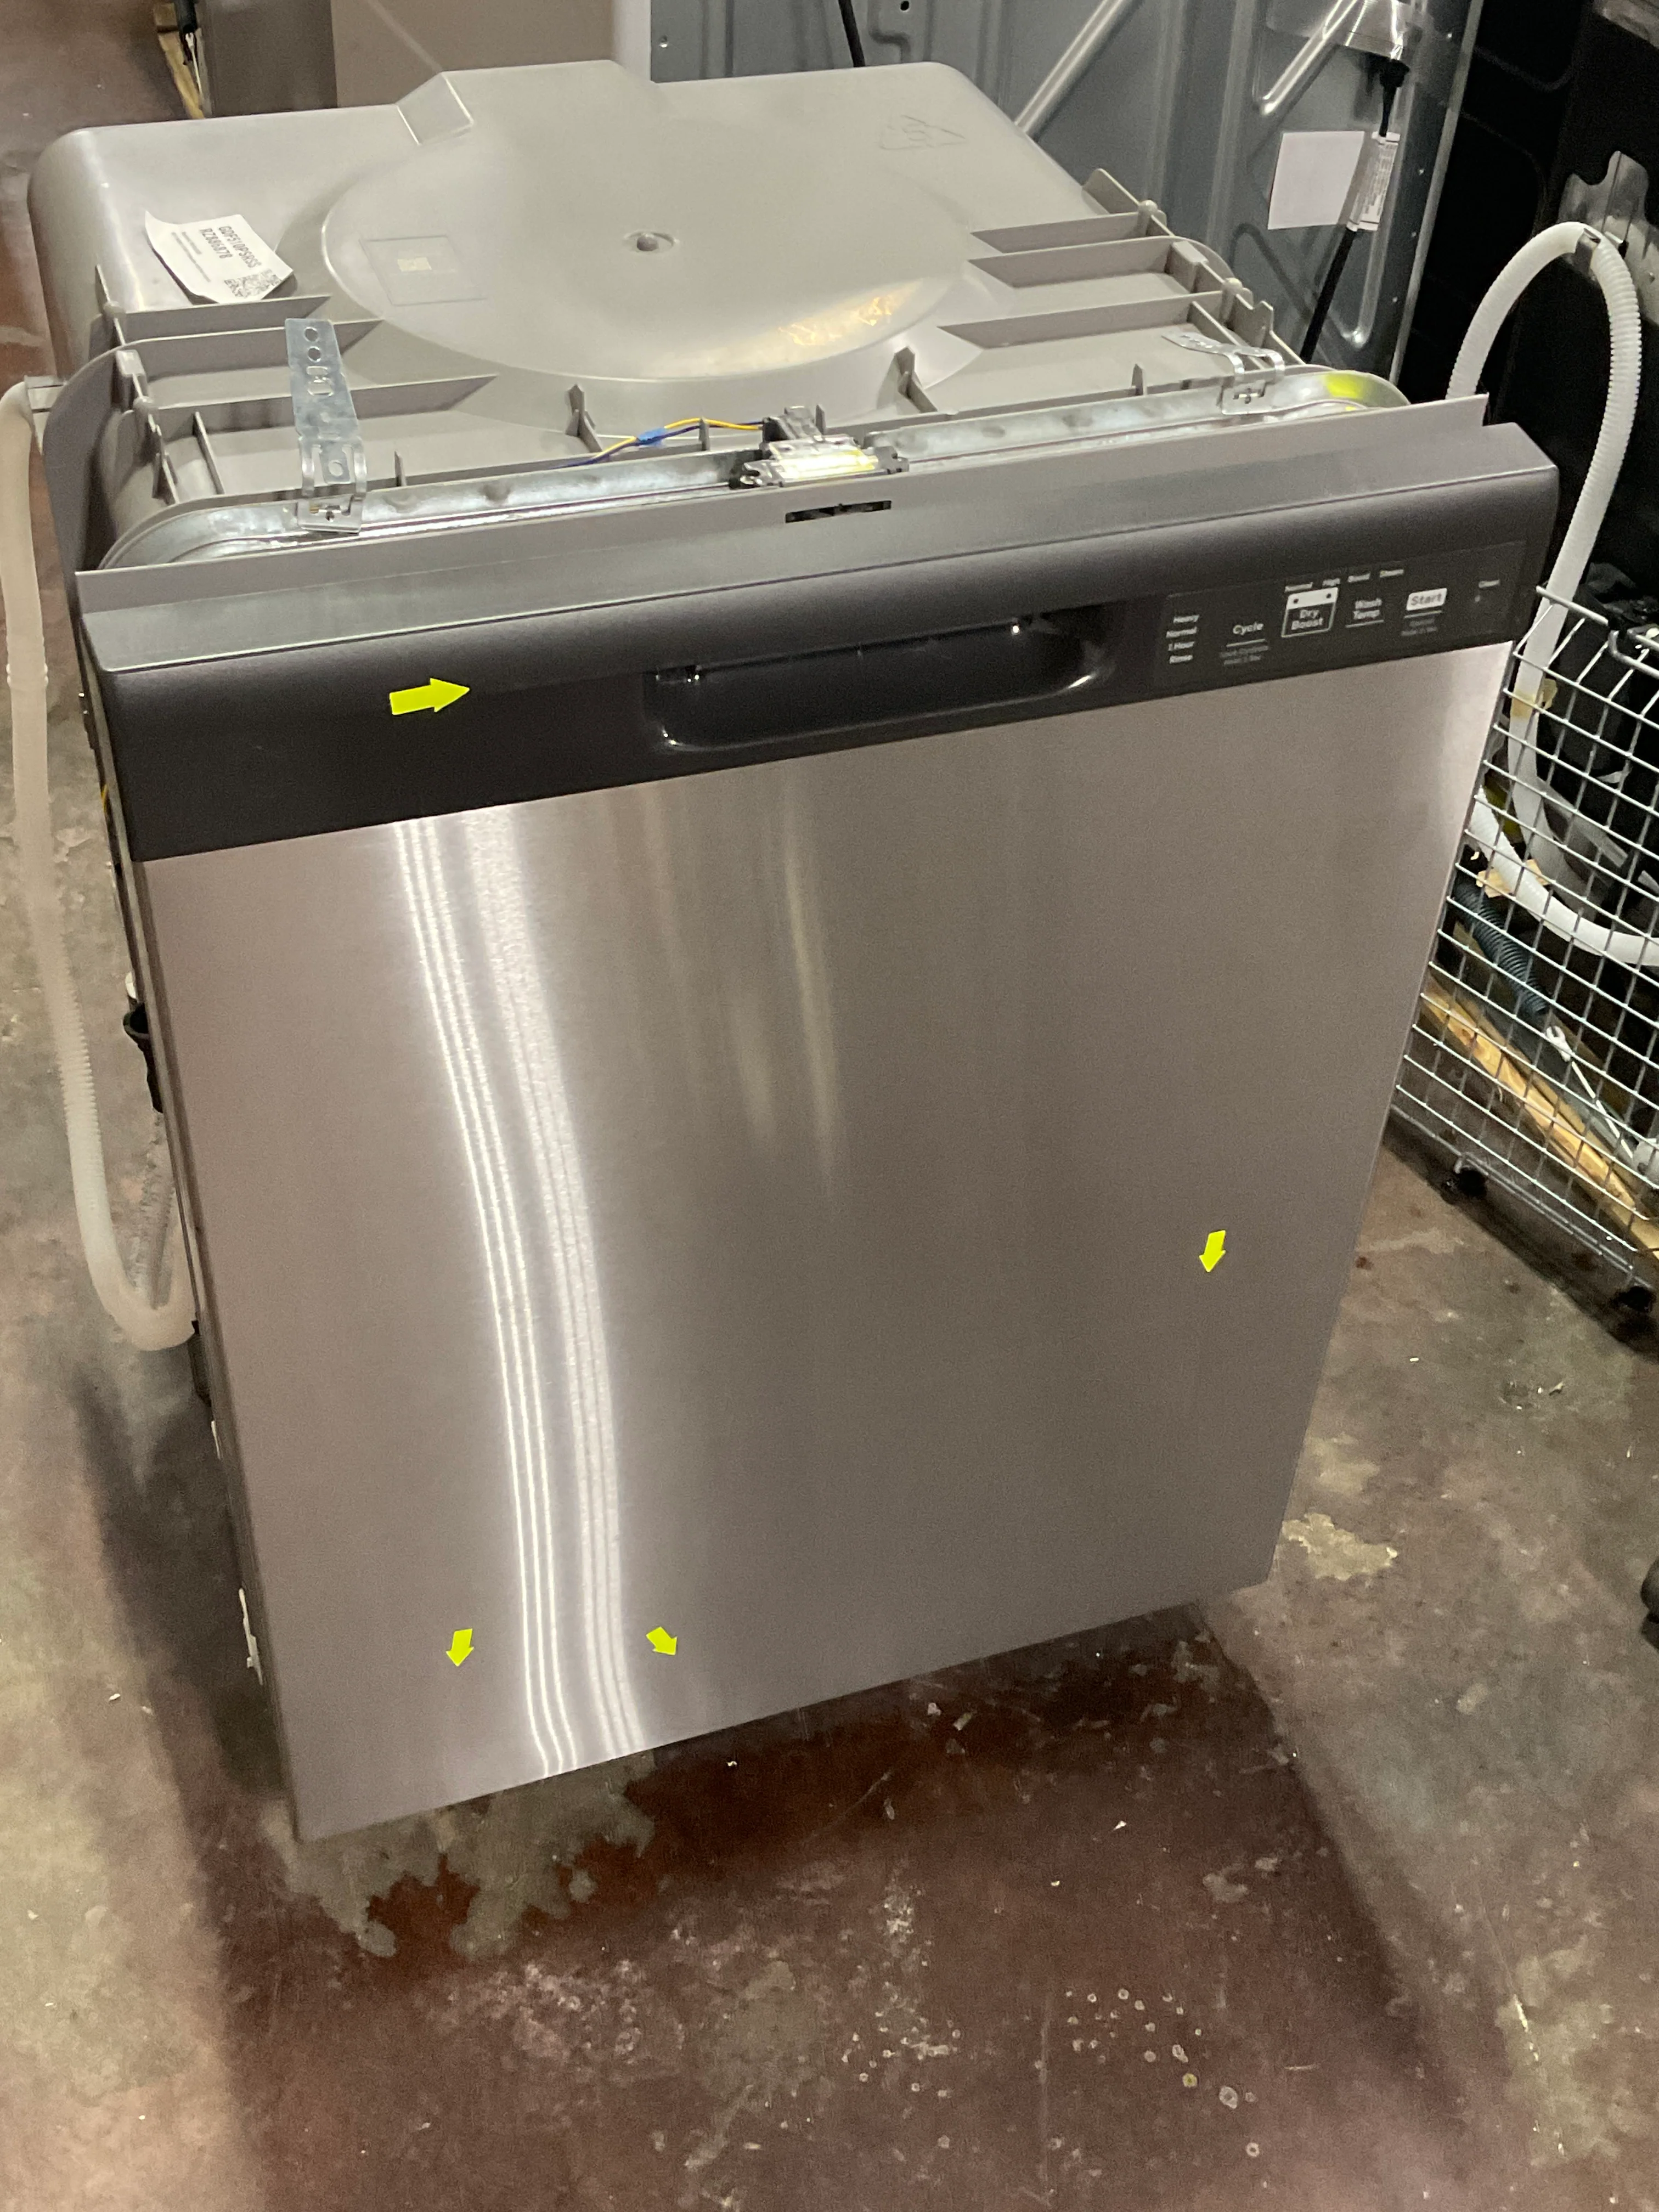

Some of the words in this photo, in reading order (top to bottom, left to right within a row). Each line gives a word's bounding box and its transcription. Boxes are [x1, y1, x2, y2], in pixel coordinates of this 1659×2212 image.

[1410, 592, 1442, 606] Start
[1300, 609, 1319, 619] Dry
[1233, 622, 1264, 635] Cycle
[1291, 617, 1323, 630] Boost
